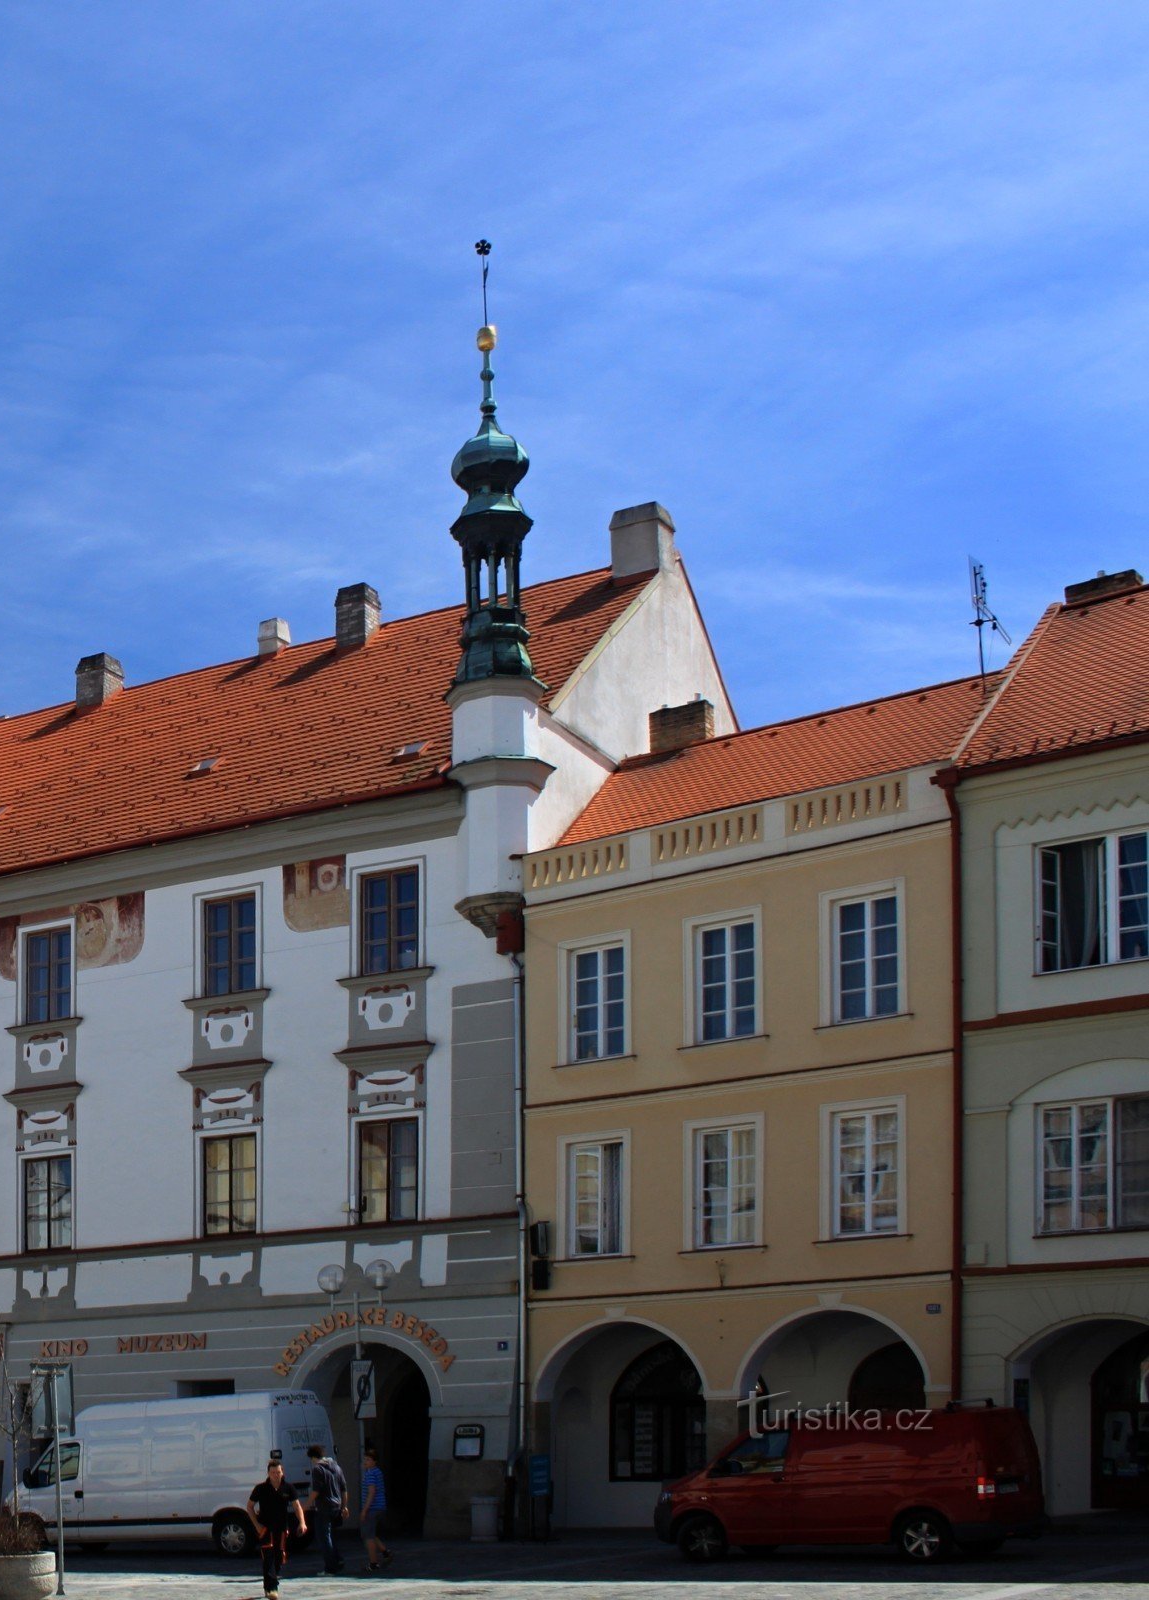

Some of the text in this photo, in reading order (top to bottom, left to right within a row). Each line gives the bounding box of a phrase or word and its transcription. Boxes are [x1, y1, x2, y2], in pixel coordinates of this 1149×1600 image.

[41, 1332, 208, 1357] KINO MUZEUM
[272, 1308, 457, 1377] RESTAURACE BESEDA
